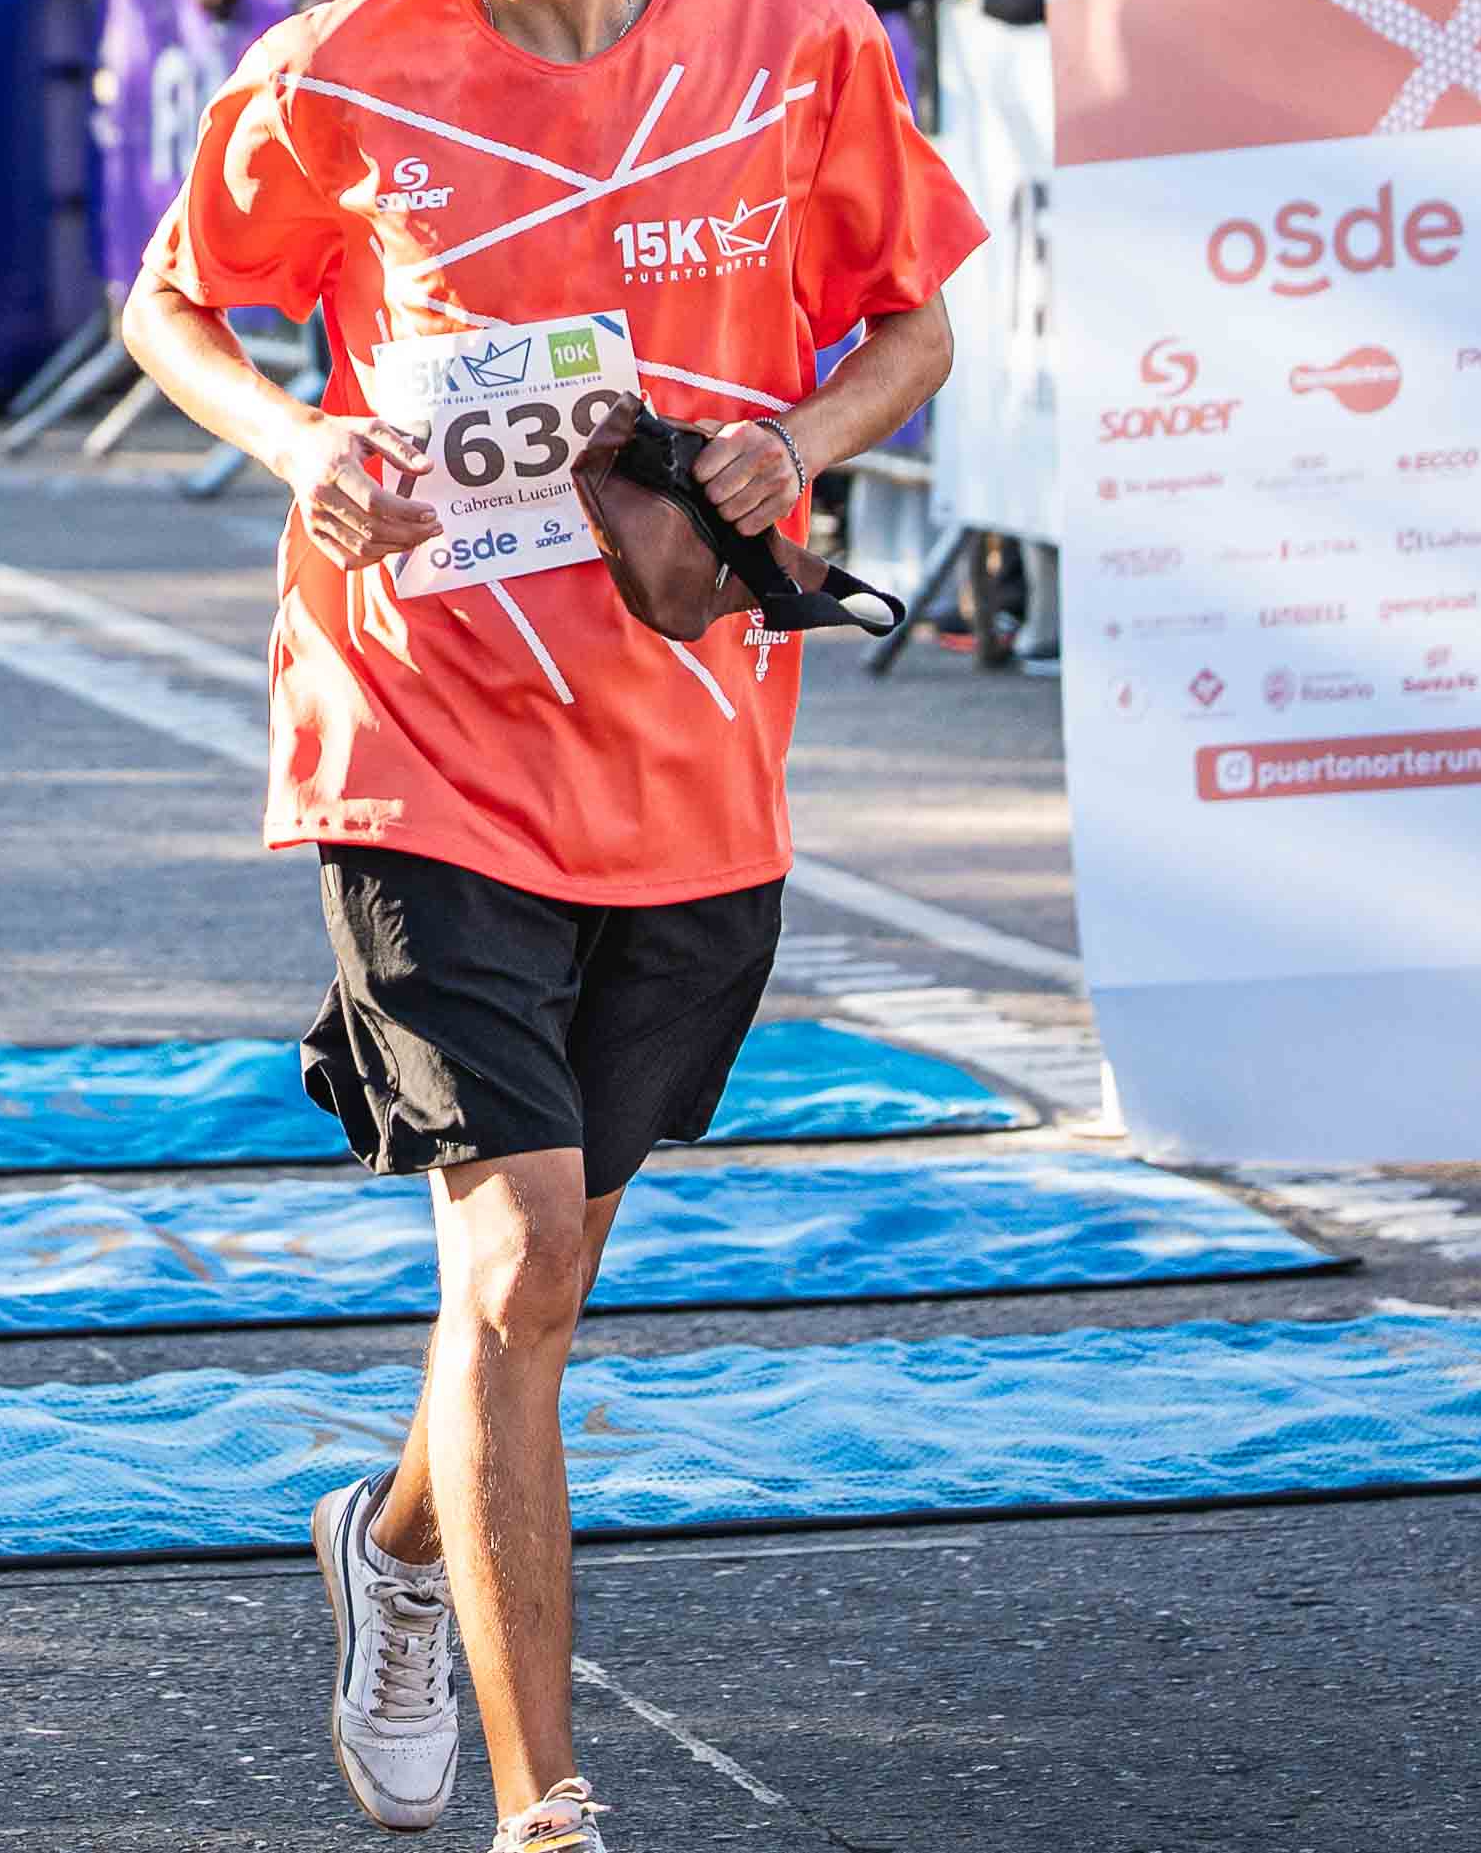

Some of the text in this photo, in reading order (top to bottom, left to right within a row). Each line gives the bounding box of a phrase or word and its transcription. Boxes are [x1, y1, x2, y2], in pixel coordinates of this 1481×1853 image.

[613, 217, 708, 269] 15K
[1207, 181, 1464, 297] osde
[624, 256, 768, 285] PUERTO NORTE
[553, 343, 593, 365] 10K
[450, 481, 576, 516] Cabrera Lucian
[430, 527, 518, 570] osde
